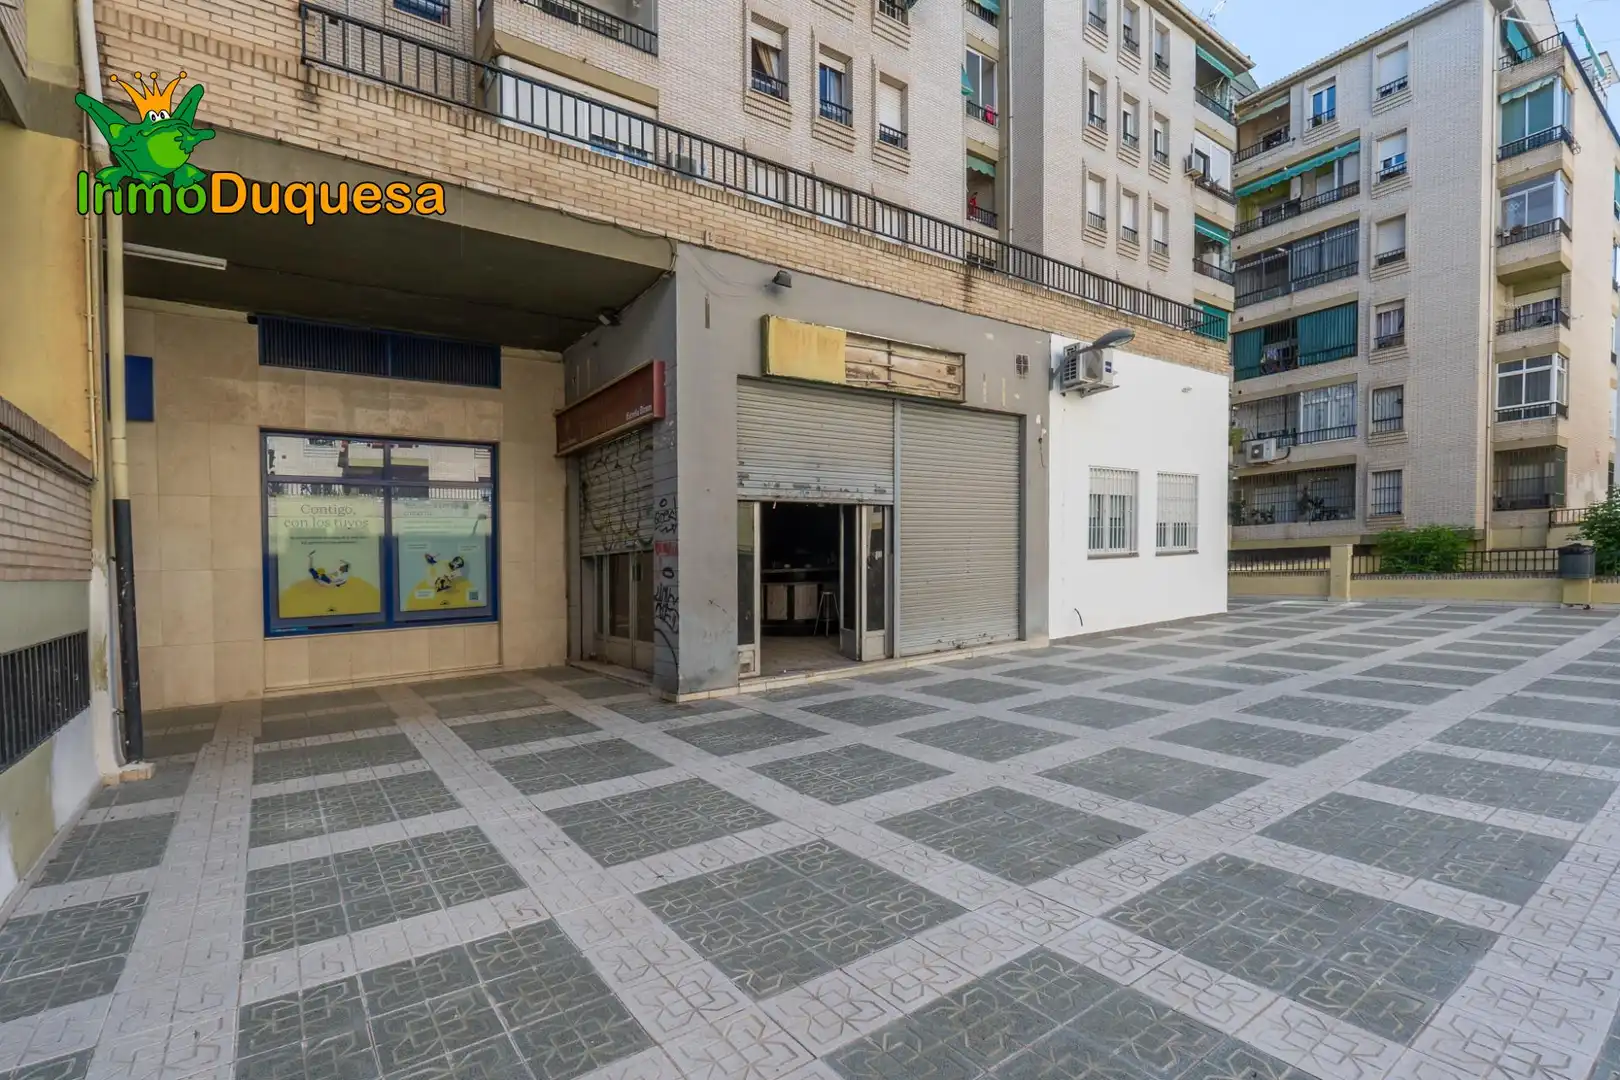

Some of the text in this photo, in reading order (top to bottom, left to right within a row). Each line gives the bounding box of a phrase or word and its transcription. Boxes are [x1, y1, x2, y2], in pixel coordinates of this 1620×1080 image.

[300, 503, 357, 516] Contigo,
[283, 519, 308, 528] con
[311, 515, 331, 528] los
